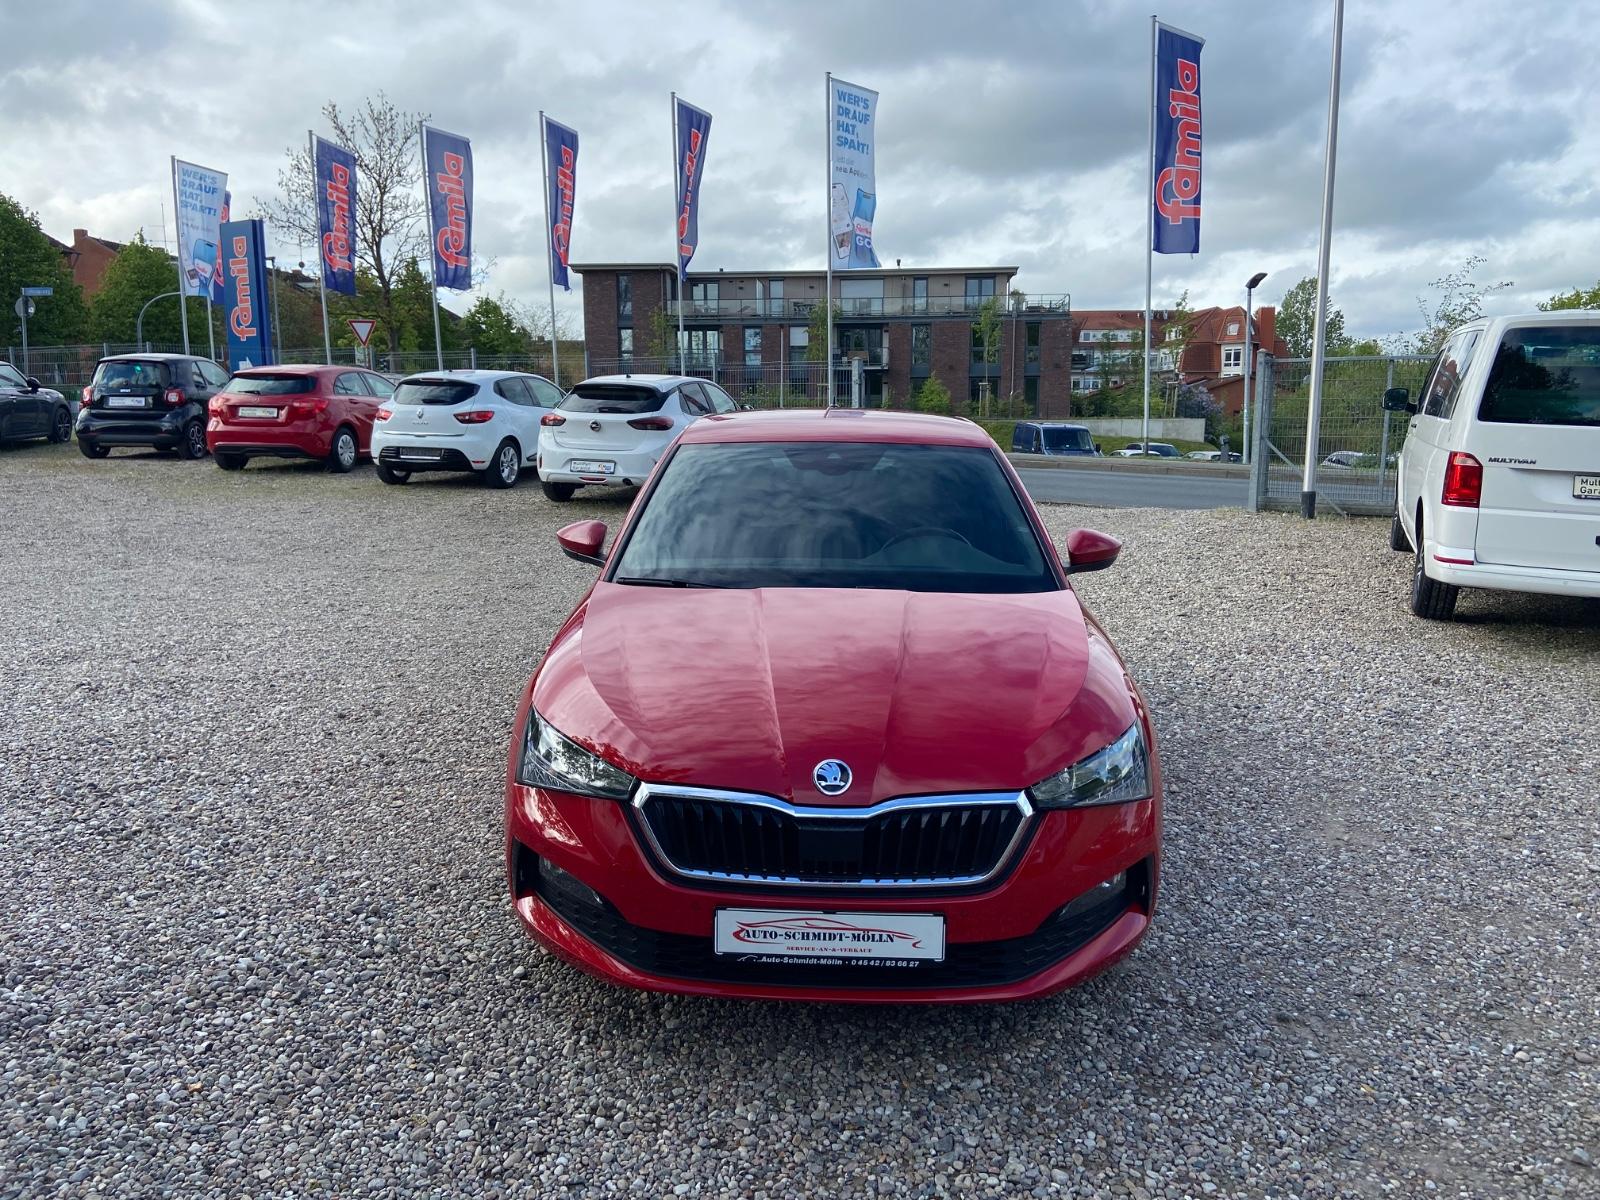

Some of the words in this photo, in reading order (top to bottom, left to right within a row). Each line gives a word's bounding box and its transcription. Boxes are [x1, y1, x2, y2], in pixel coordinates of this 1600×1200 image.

[837, 89, 870, 110] WER'S
[837, 105, 871, 125] DRAUF
[836, 120, 859, 138] HAT,
[1156, 58, 1201, 225] famila
[182, 168, 218, 185] WER'S
[181, 179, 218, 196] DRAUF
[323, 162, 353, 272] famila
[436, 151, 468, 269] famila
[229, 235, 257, 341] famila
[743, 929, 895, 943] AUTO-SCHMIDT-MÖLLN
[760, 956, 843, 966] Auto-Schmidt-Mölln
